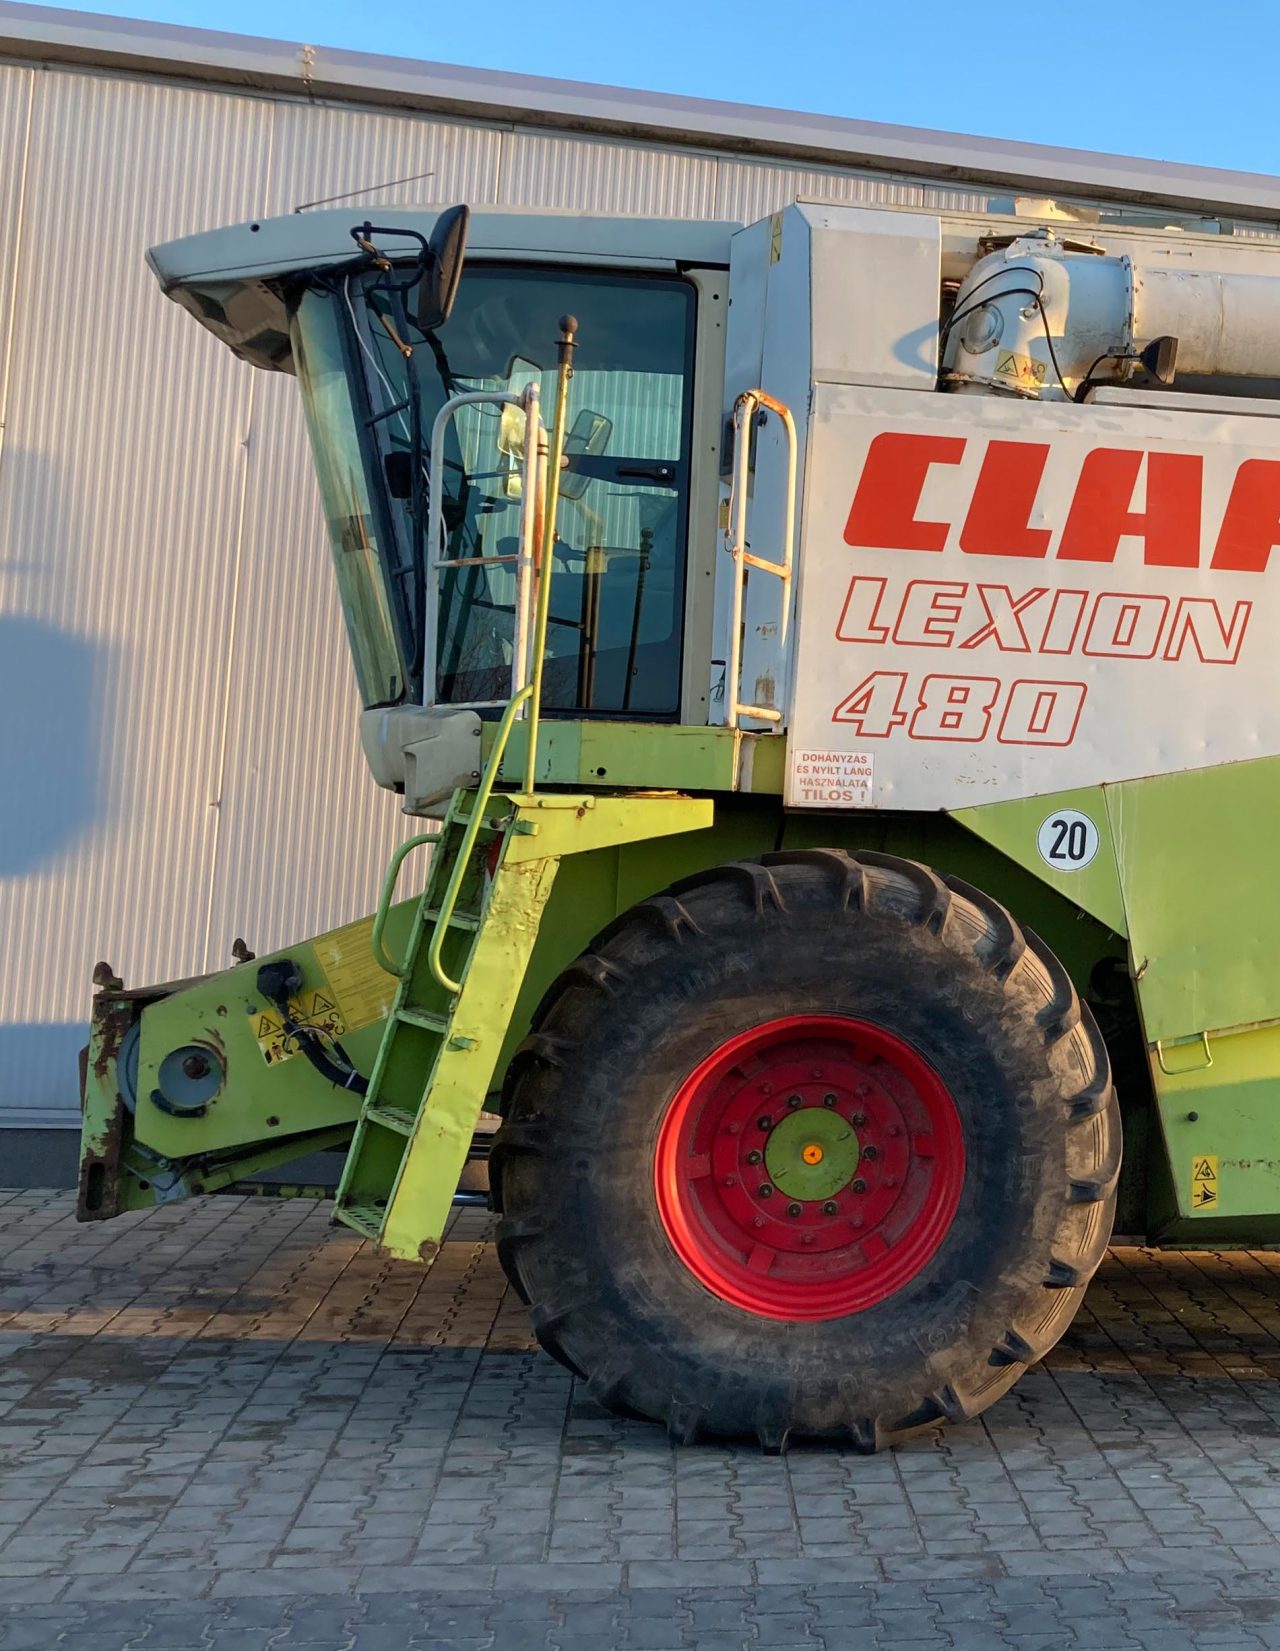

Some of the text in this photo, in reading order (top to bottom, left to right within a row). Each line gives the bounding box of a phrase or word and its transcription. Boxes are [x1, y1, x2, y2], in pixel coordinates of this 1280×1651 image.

[835, 576, 1252, 664] LEXION
[832, 671, 1087, 746] 480
[802, 789, 853, 801] TILOS
[1049, 820, 1088, 862] 20
